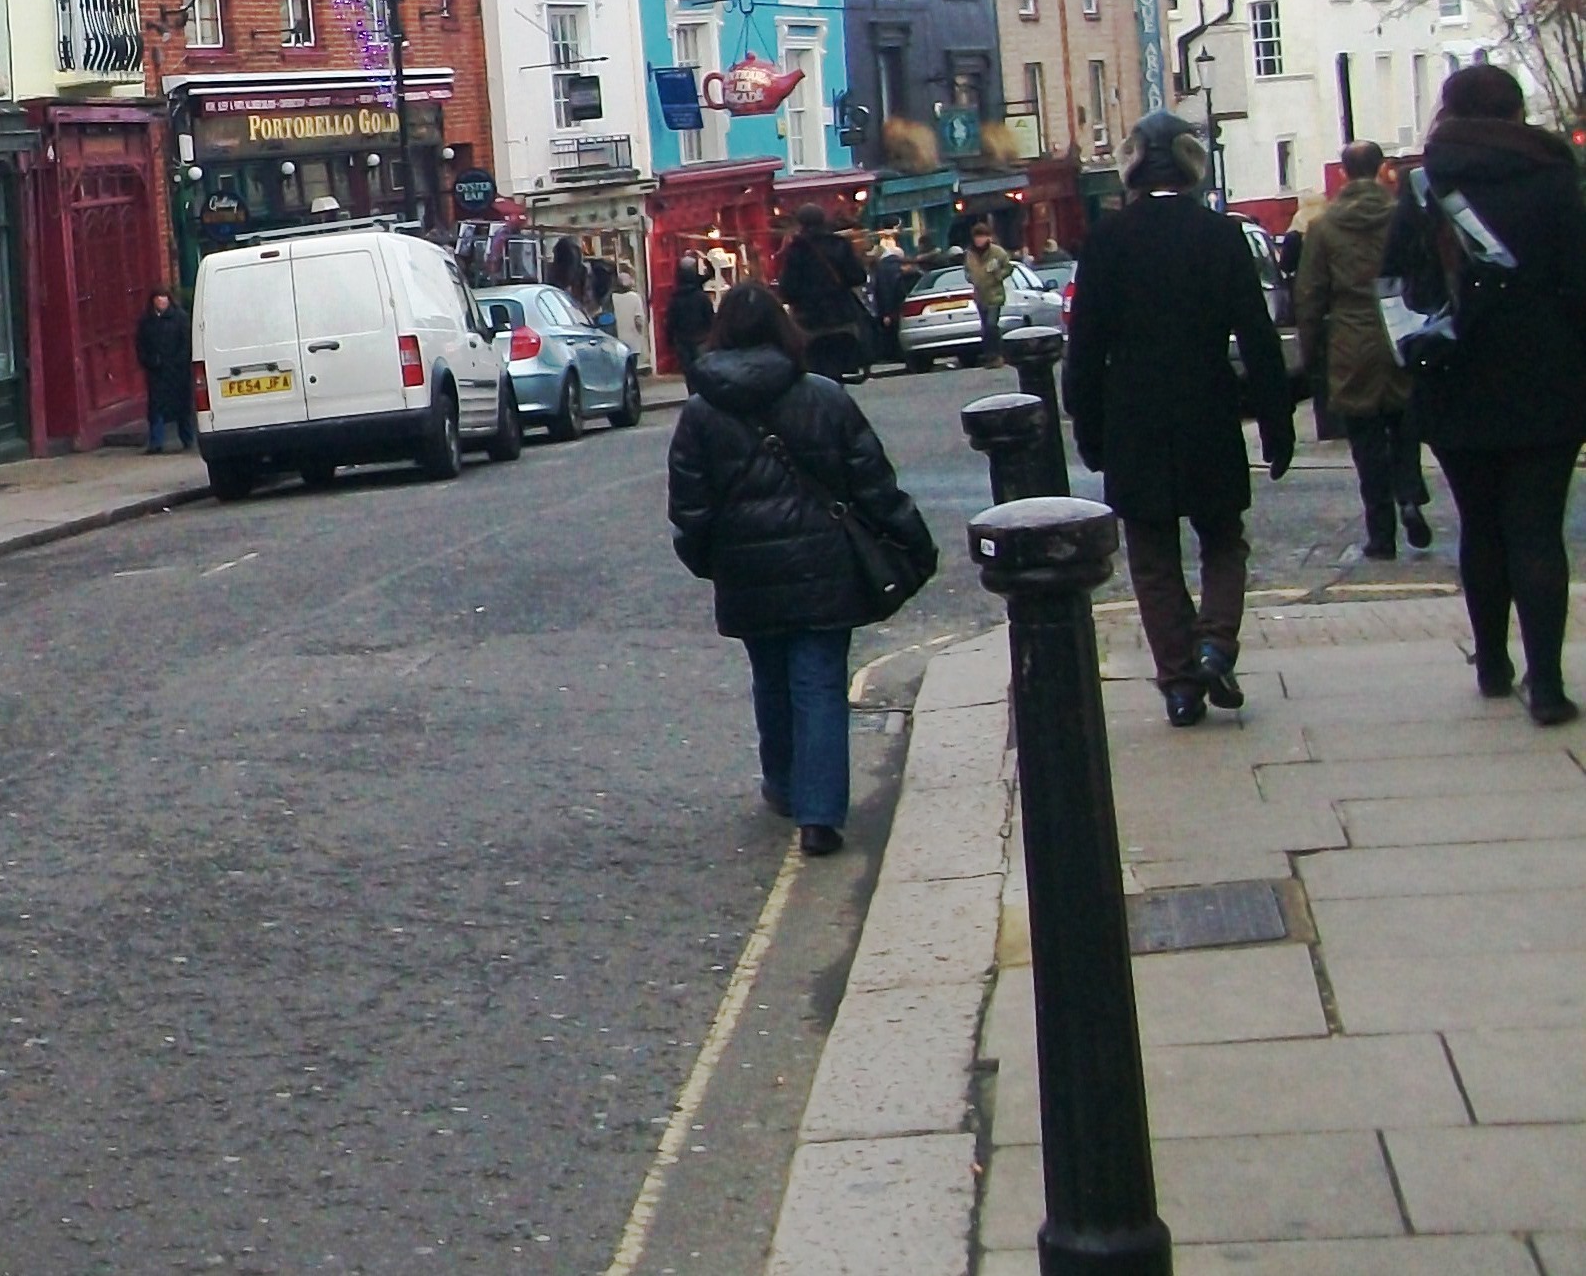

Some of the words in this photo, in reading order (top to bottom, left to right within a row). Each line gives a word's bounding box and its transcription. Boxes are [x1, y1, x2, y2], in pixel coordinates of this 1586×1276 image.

[1145, 41, 1163, 113] ARCAD
[249, 113, 354, 141] PORTOBELLO
[358, 109, 400, 135] GOLD
[455, 182, 491, 193] OYSTER
[464, 192, 484, 201] BAR
